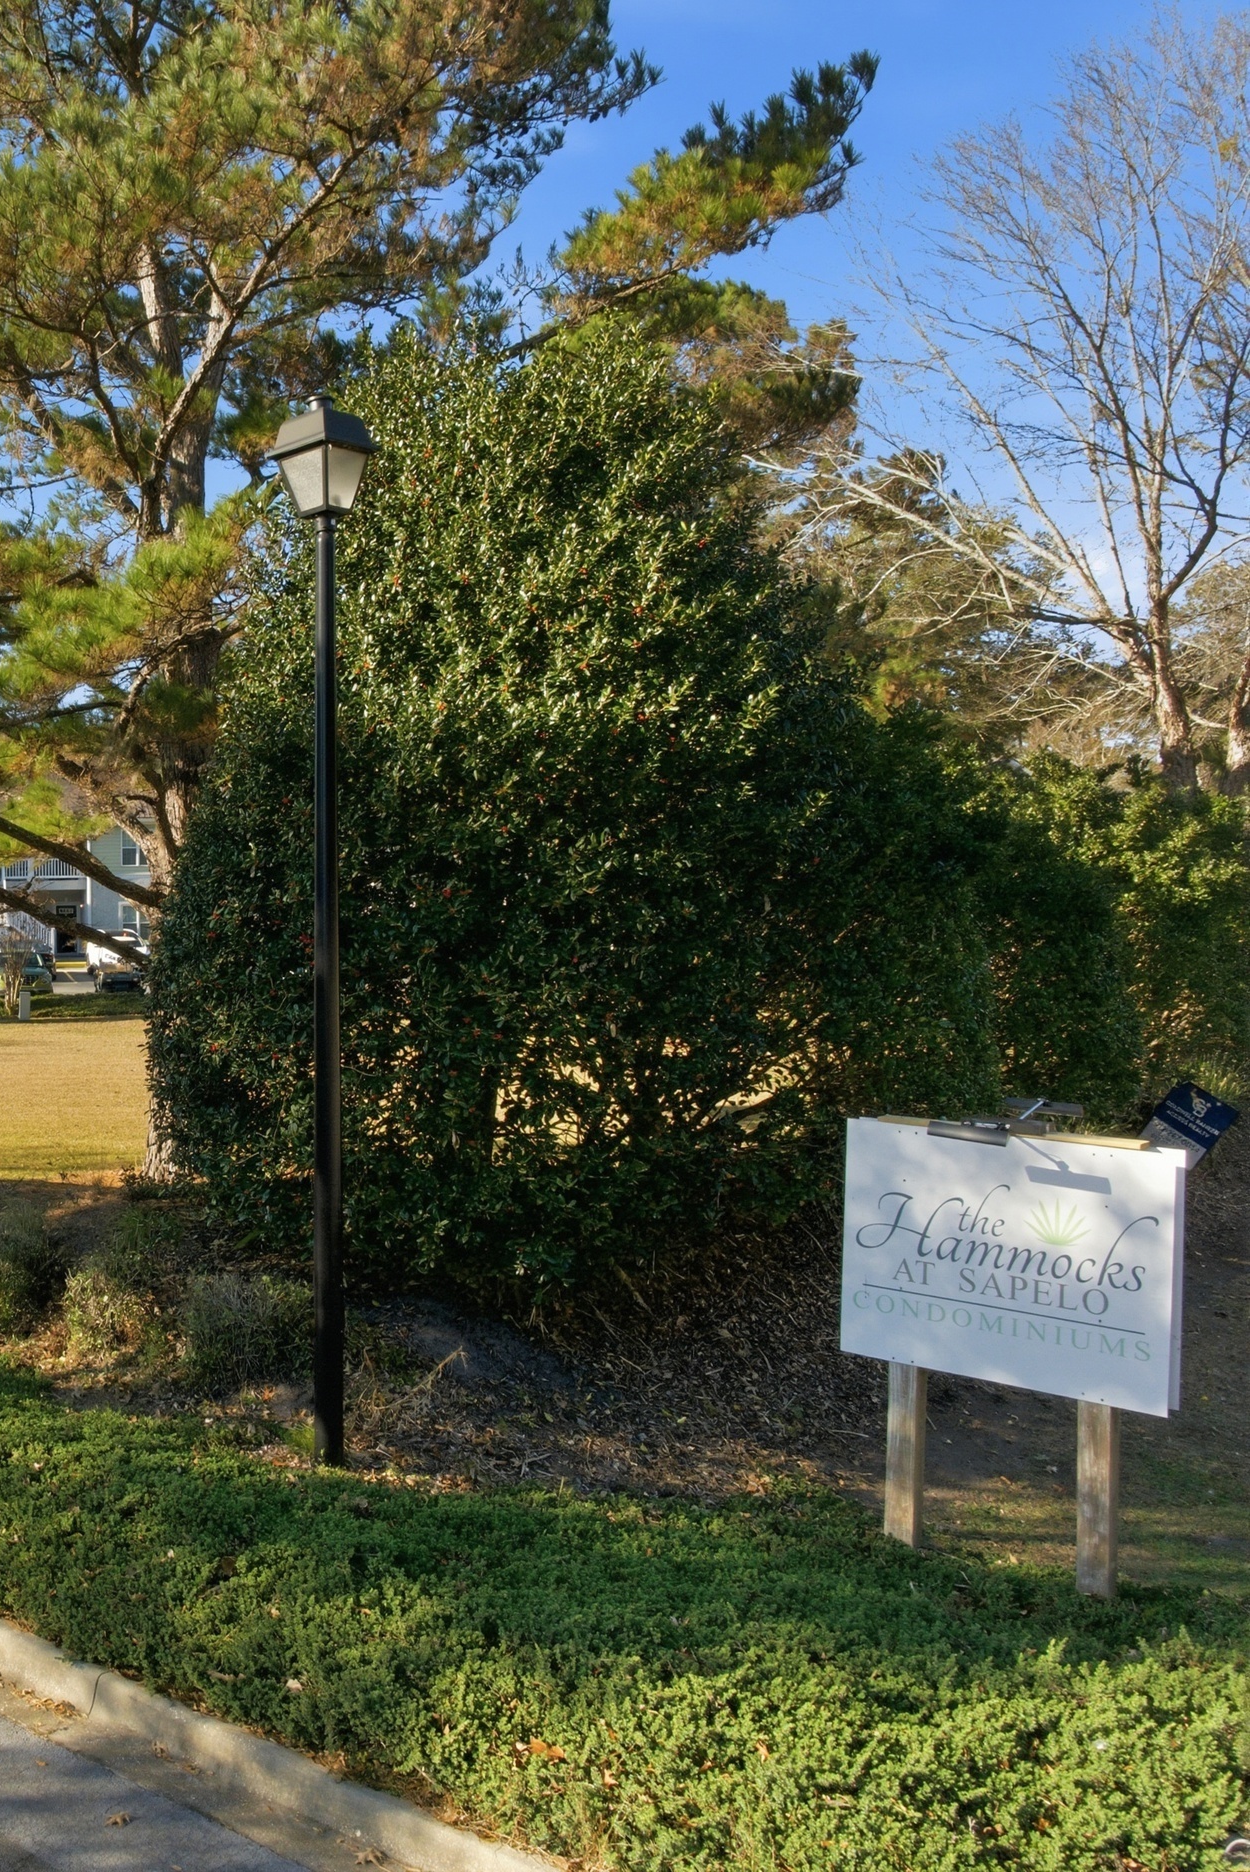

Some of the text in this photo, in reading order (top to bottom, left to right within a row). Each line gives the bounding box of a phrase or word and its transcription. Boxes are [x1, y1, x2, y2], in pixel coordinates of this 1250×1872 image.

[856, 1192, 1159, 1292] Hammocks
[958, 1184, 1011, 1237] the
[892, 1258, 1110, 1316] AT SAPELO
[853, 1290, 1151, 1362] CONDOMINIUMS
